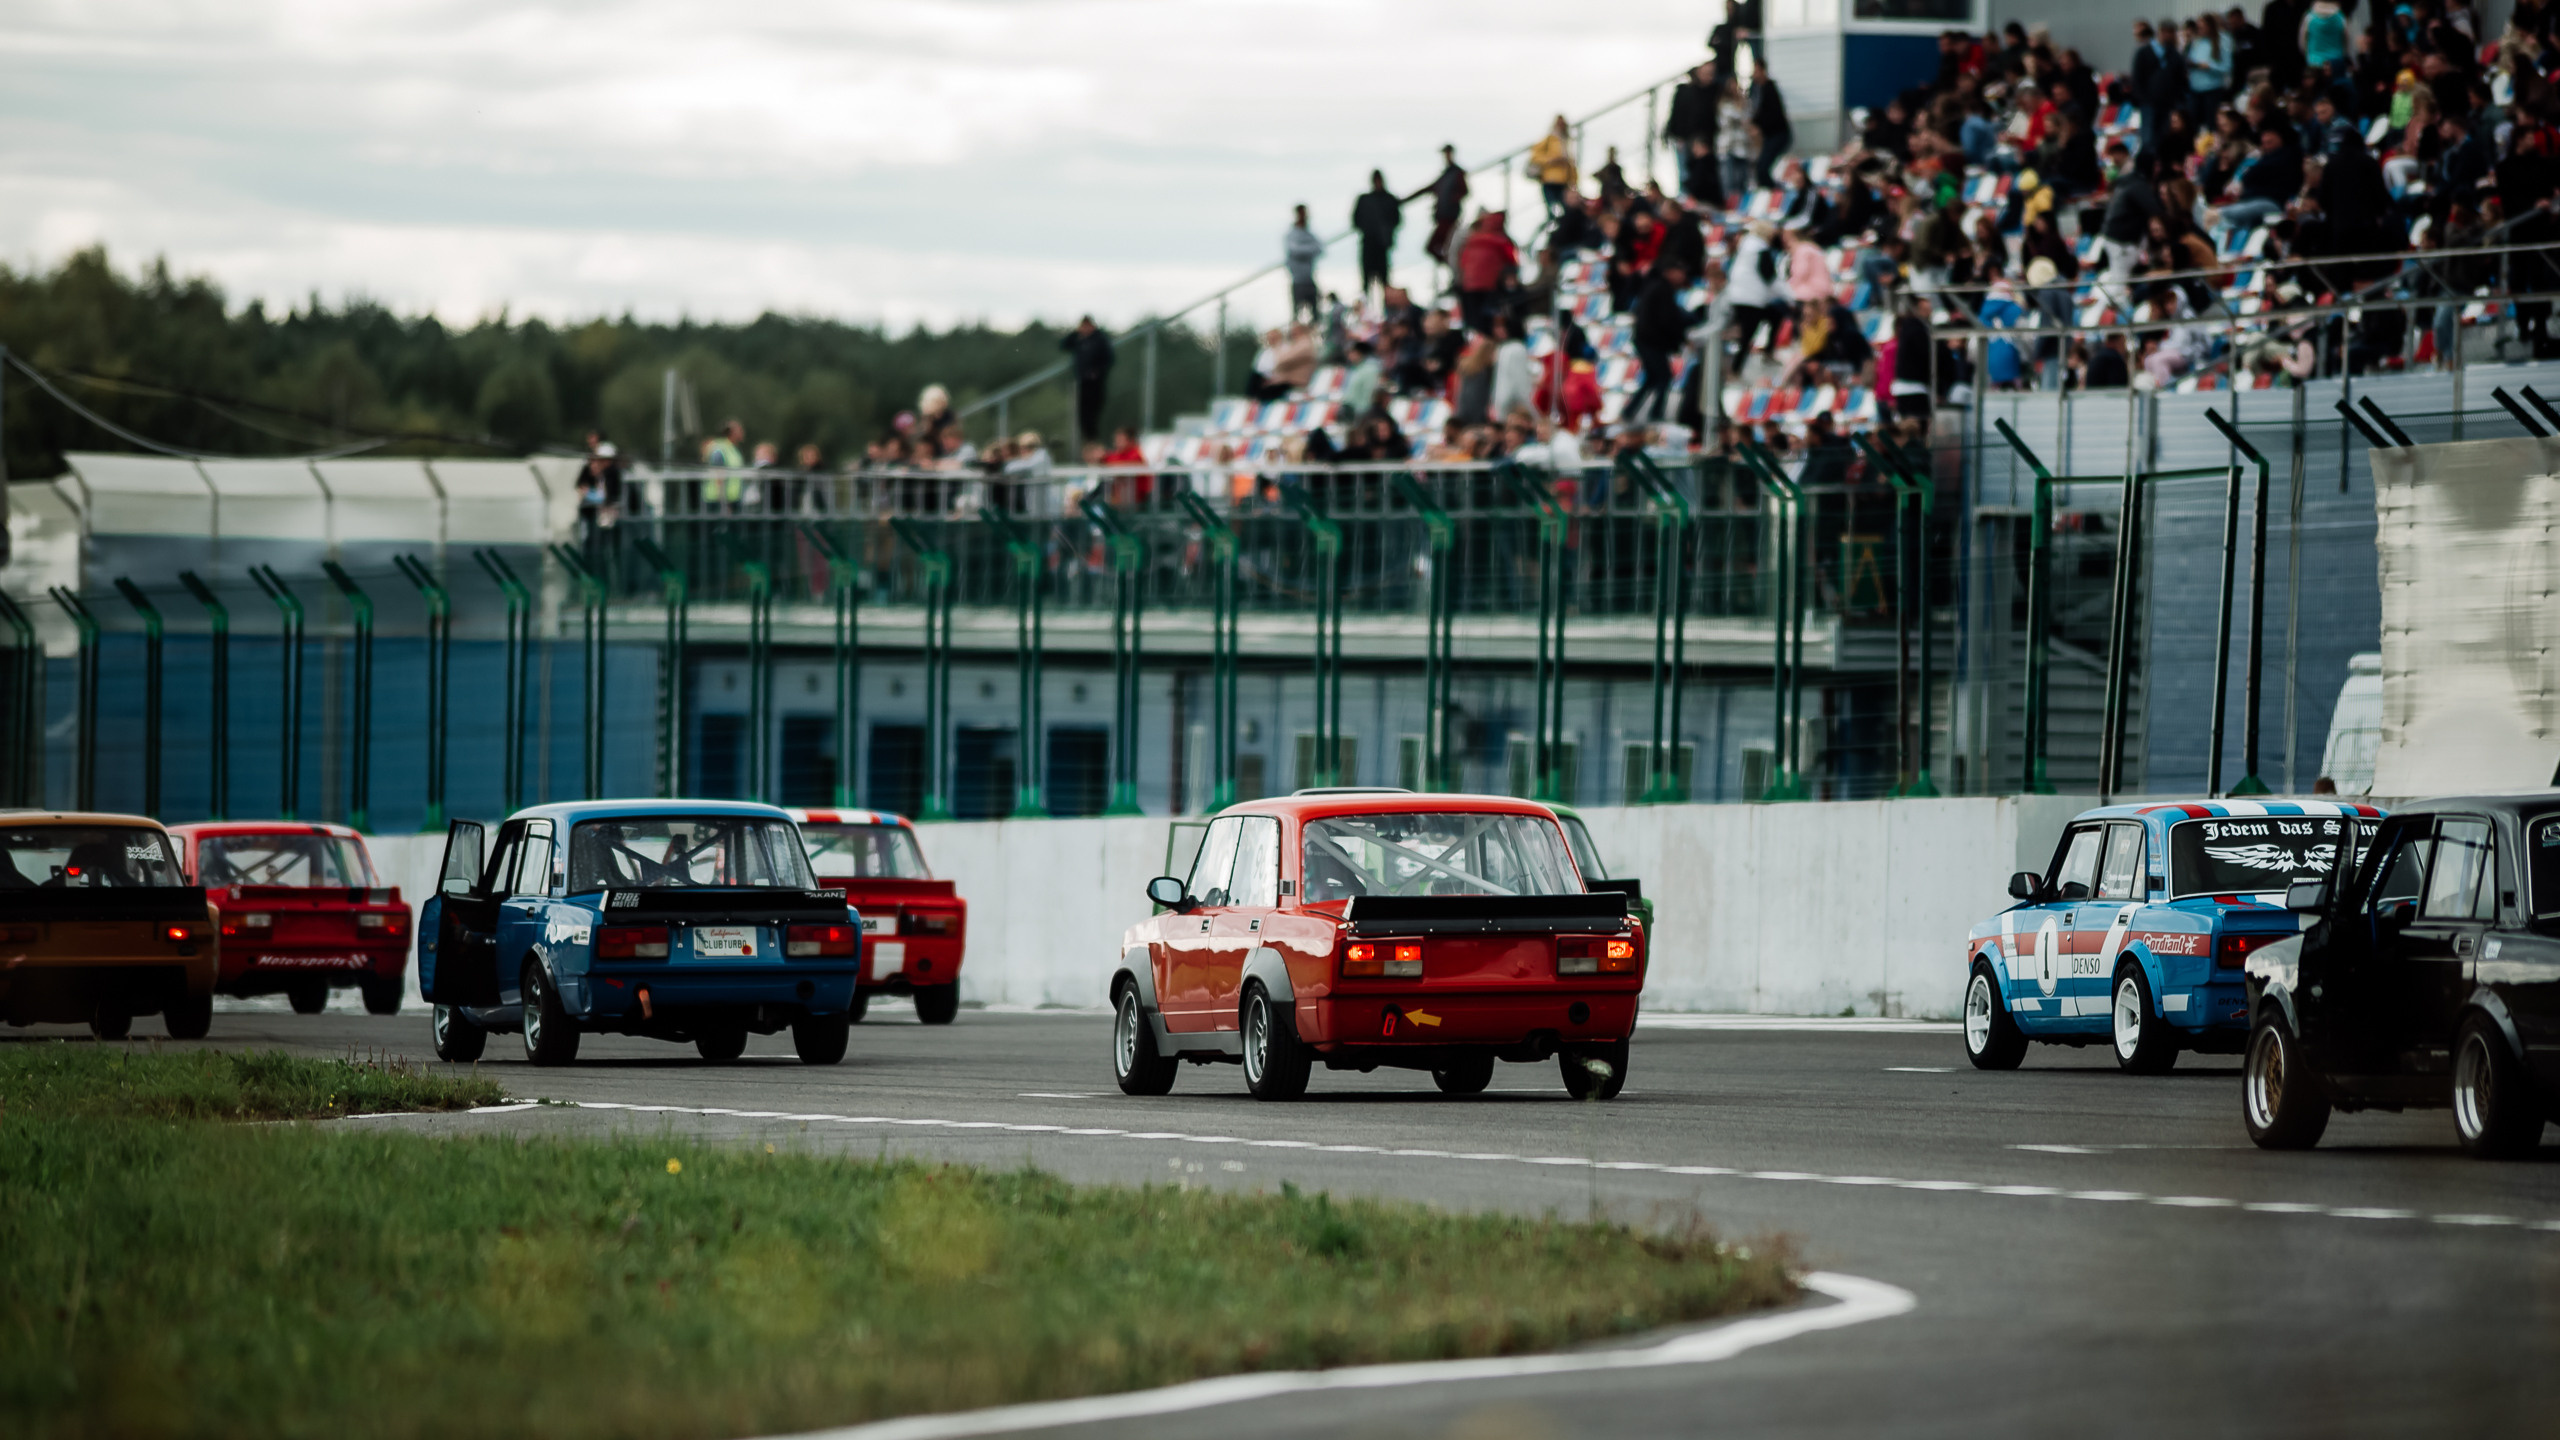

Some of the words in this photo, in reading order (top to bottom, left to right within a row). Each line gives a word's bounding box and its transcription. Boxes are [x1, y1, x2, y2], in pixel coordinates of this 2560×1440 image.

[2202, 822, 2270, 841] Jedem
[2277, 820, 2314, 835] das
[710, 928, 742, 938] California
[2143, 933, 2185, 953] Cordiant
[257, 954, 346, 967] Motorsports
[2044, 931, 2050, 980] 1
[2073, 958, 2101, 974] DENSO
